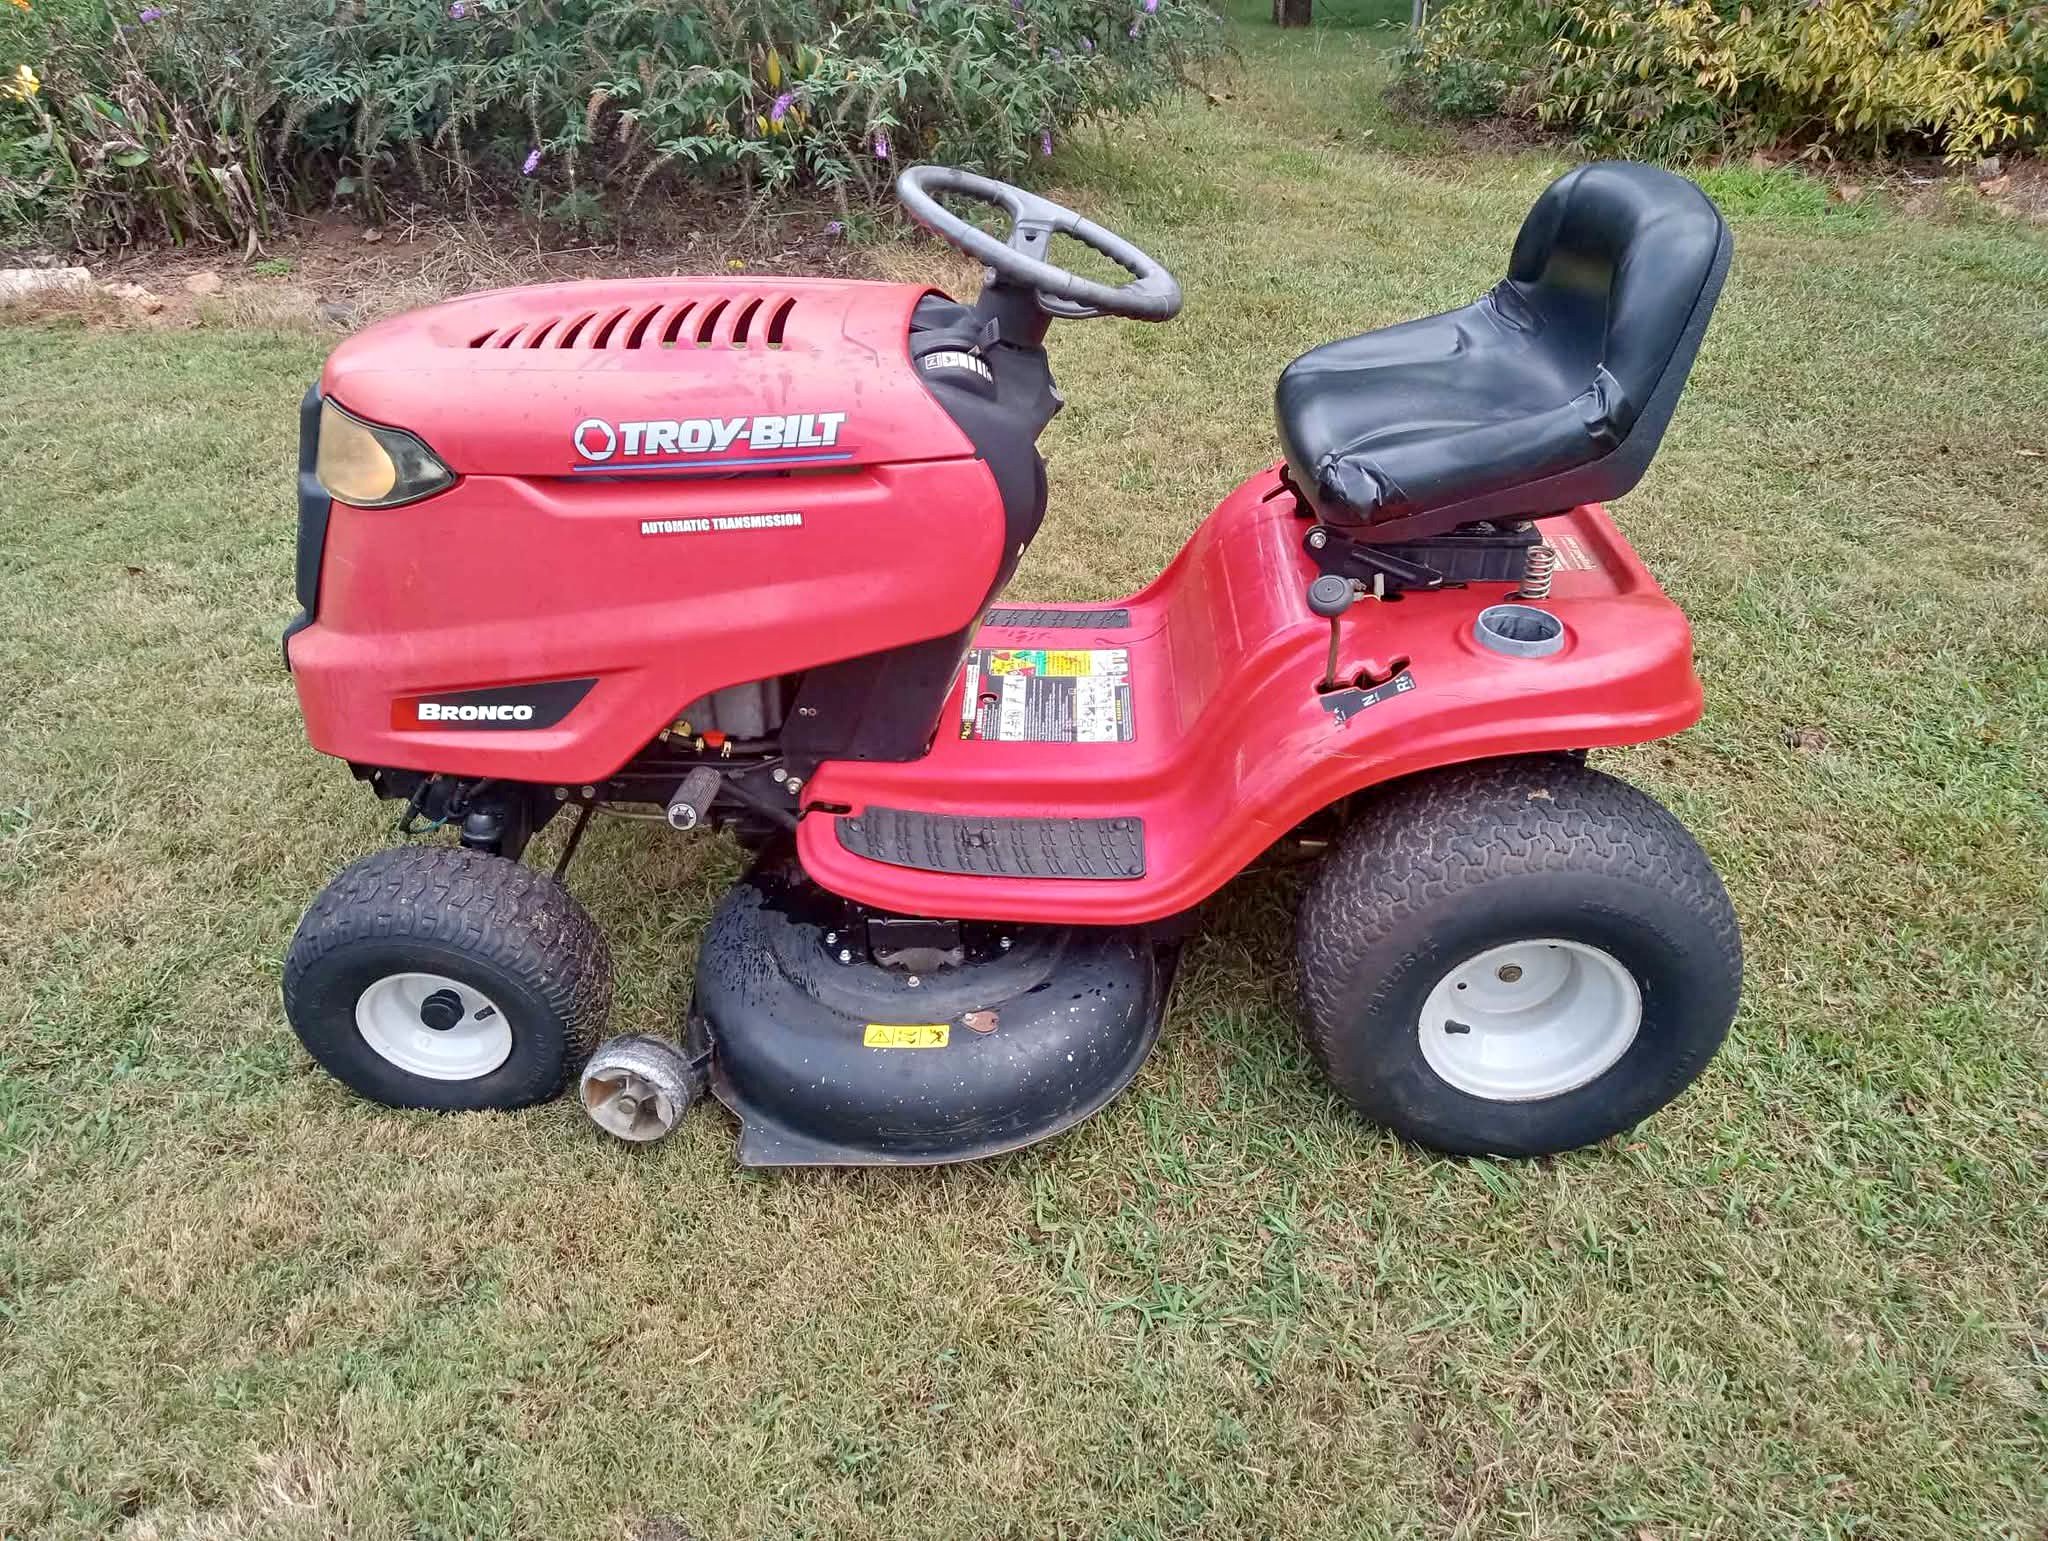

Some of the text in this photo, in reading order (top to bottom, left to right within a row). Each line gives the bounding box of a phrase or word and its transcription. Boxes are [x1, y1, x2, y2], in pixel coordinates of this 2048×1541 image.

[619, 412, 846, 456] TROY-BILT
[641, 513, 802, 535] AUTOMATIC TRANSMISSION
[418, 703, 533, 721] BRONCO
